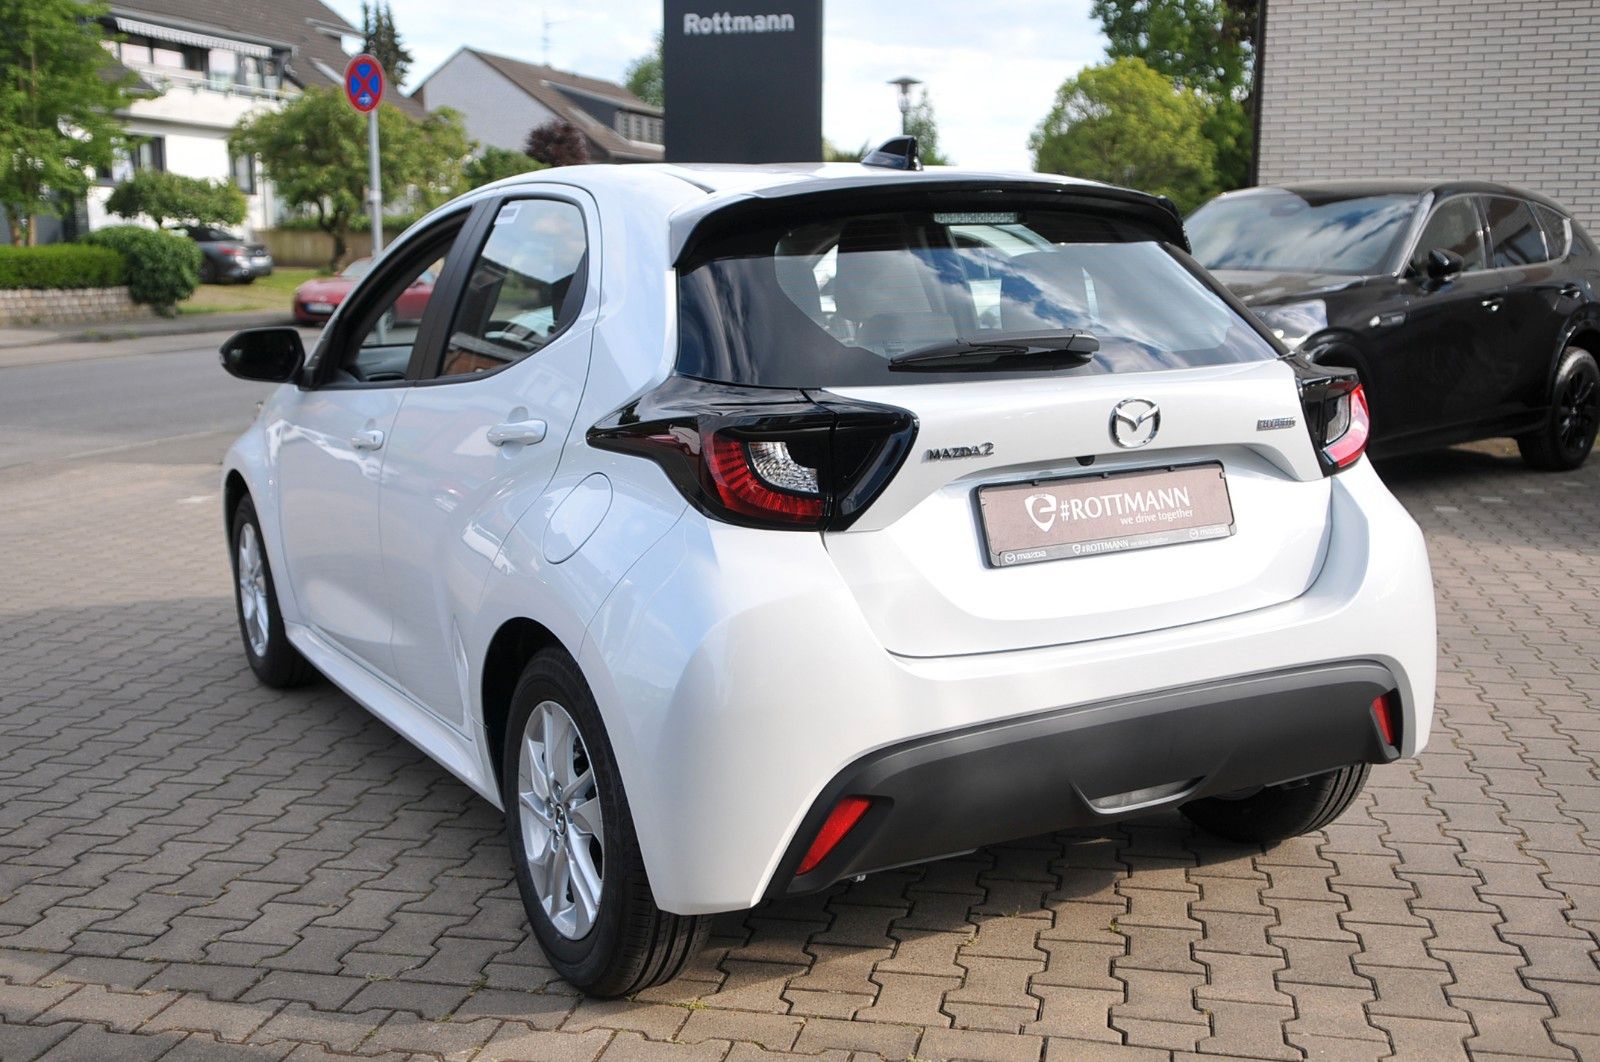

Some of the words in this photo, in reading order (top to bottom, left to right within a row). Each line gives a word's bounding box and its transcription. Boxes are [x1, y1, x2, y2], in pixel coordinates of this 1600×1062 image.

[683, 11, 795, 35] Rottmann
[1060, 486, 1191, 522] #ROTTMANN
[1120, 516, 1134, 525] we
[1136, 513, 1157, 524] drive
[1158, 508, 1194, 522] together
[1082, 539, 1129, 553] #ROTTMANN
[1017, 550, 1047, 560] mazda
